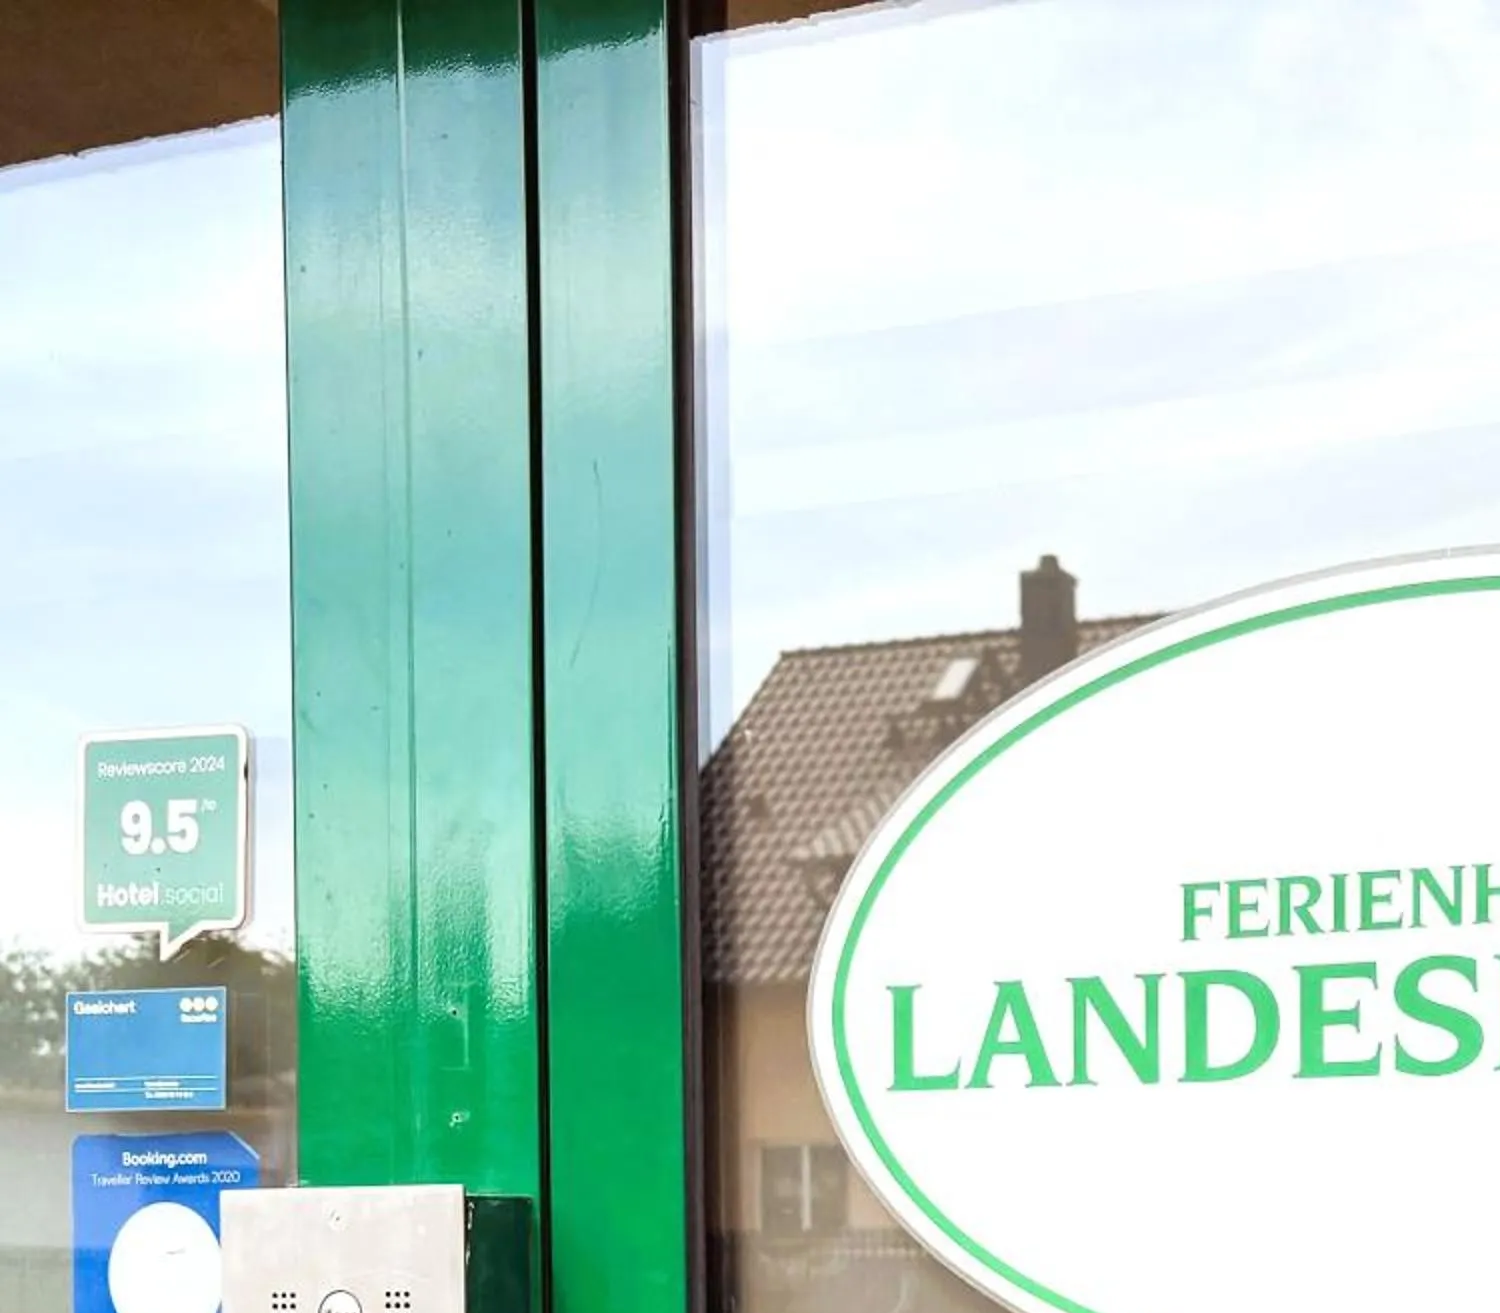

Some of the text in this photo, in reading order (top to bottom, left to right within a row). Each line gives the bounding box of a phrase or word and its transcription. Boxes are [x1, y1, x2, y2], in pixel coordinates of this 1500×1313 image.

[98, 756, 225, 778] Reviewscore 2024
[121, 799, 199, 855] 9.5
[122, 1151, 207, 1168] Booking.com
[135, 1172, 170, 1185] Review
[172, 1172, 209, 1184] Awards
[211, 1169, 241, 1183] 2020
